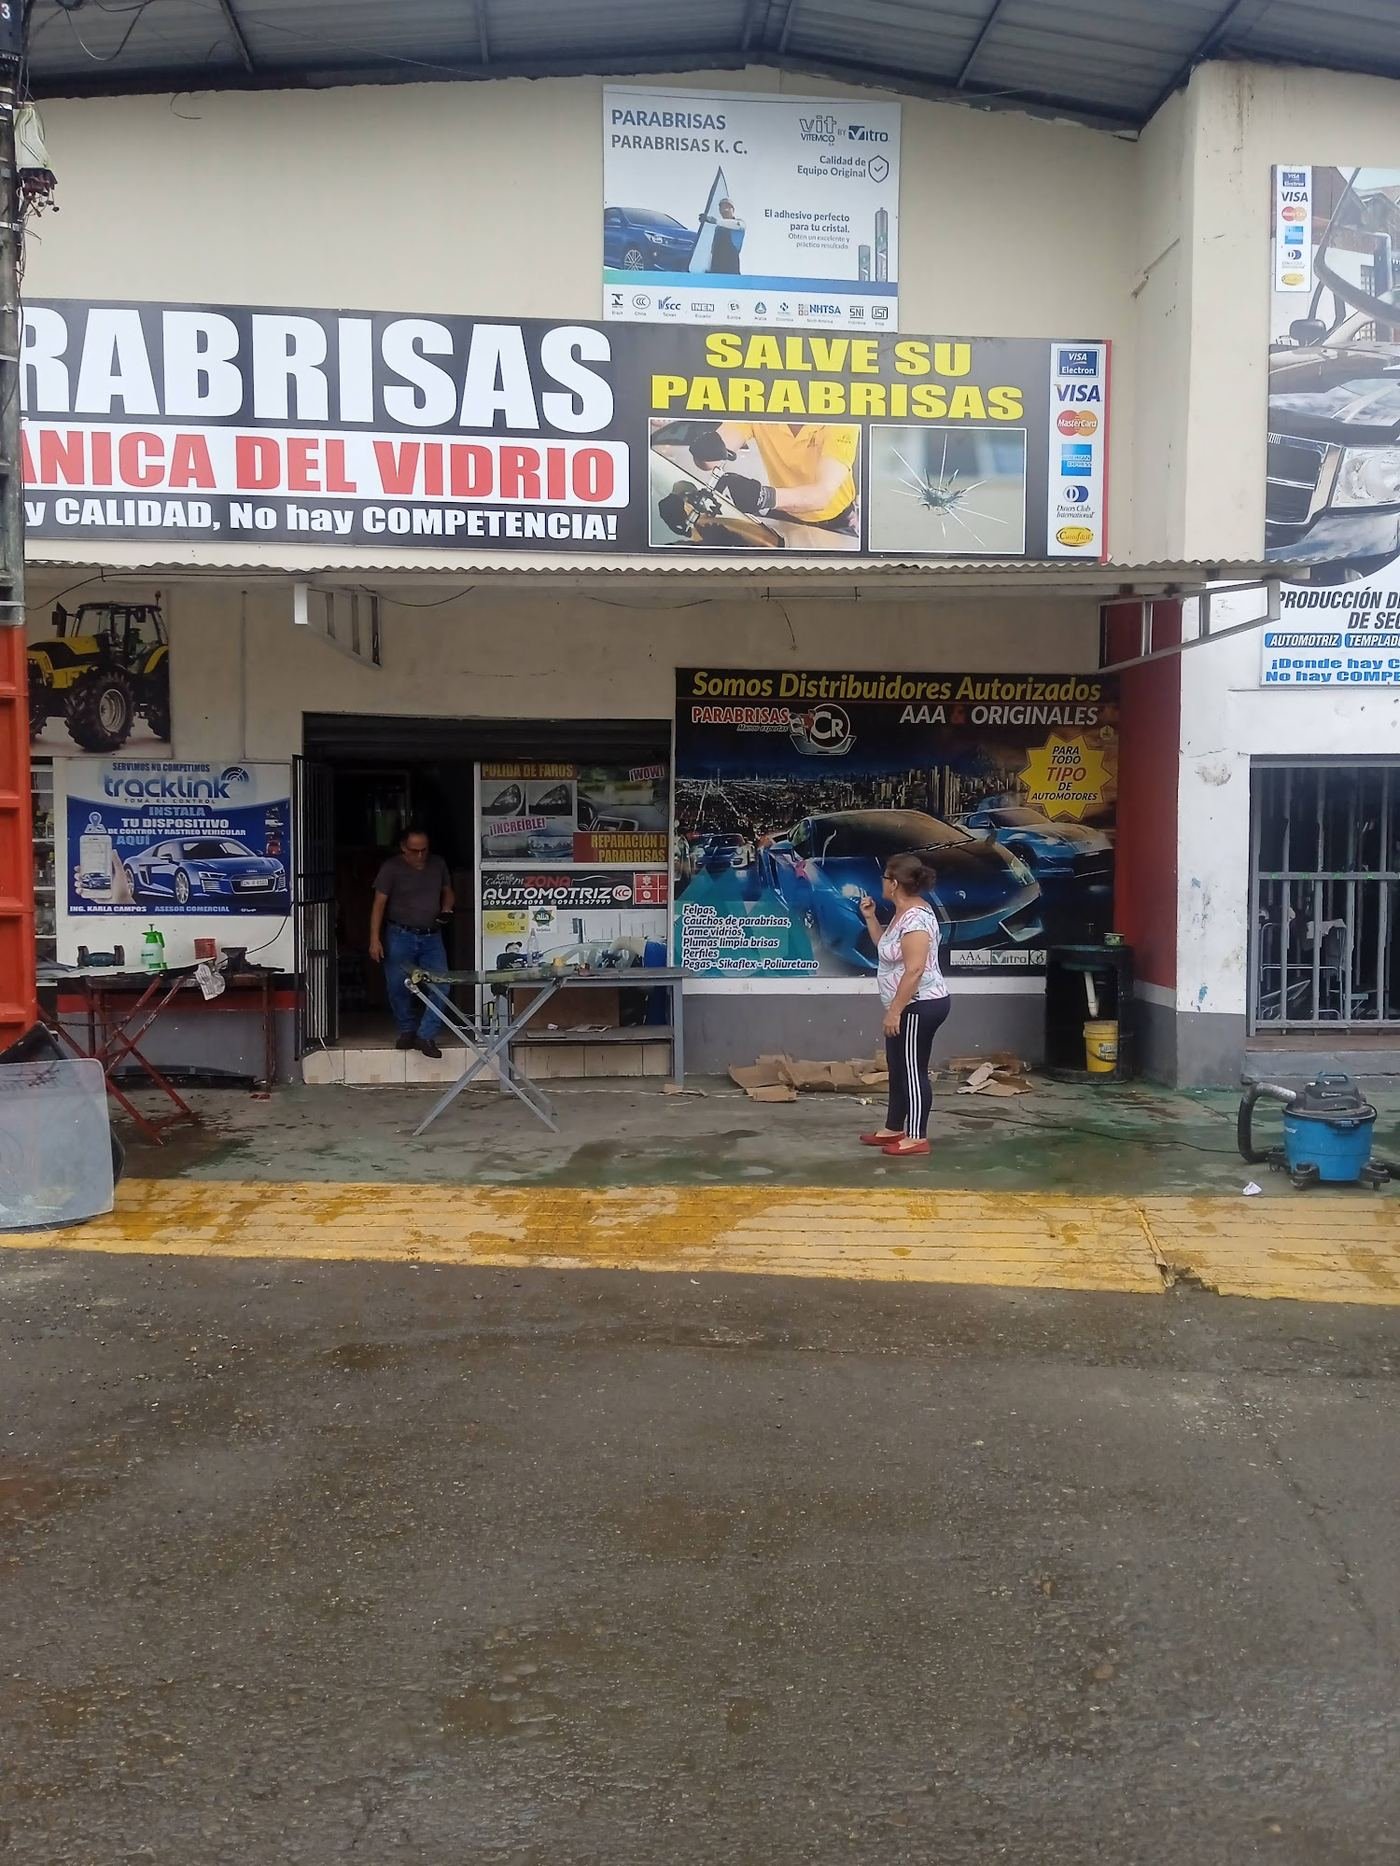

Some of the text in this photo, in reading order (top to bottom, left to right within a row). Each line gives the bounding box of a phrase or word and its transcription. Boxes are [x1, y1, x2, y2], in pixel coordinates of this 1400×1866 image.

[611, 109, 726, 130] PARABRISAS
[801, 133, 836, 143] VITEMCO
[849, 126, 889, 142] Vitro
[611, 134, 748, 154] PARABRISAS K. C.
[820, 155, 867, 166] Calidad de
[797, 165, 866, 178] Equipo Original
[1281, 192, 1308, 202] VISA
[764, 209, 850, 222] El adhesivo perfecto
[790, 223, 850, 233] para tu cristal.
[809, 304, 841, 314] NHTSA
[705, 333, 972, 377] SALVE SU
[1068, 353, 1087, 361] VISA
[1061, 366, 1095, 374] Electron
[651, 374, 1024, 420] PARABRISAS
[1054, 383, 1101, 402] VISA
[1057, 419, 1097, 428] MasterCard
[235, 436, 357, 493] DEL
[373, 440, 615, 502] VIDRIO
[25, 498, 618, 541] y CALIDAD, No hay COMPETENCIA!
[1386, 592, 1400, 608] D
[1348, 612, 1371, 629] DE
[1270, 635, 1340, 646] AUTOMOTRIZ
[1272, 658, 1342, 669] ¡Donde
[1347, 658, 1383, 669] hay
[1266, 672, 1291, 681] No
[1296, 671, 1332, 682] hay
[692, 671, 1101, 701] Somos Distribuidores Autorizados
[692, 706, 789, 724] PARABRISAS
[900, 705, 946, 724] AAA
[971, 705, 1098, 725] ORIGINALES
[1052, 746, 1079, 755] PARA
[1051, 755, 1081, 765] TODO
[113, 762, 210, 772] SERVIMOS NO COMPETIMOS
[523, 764, 537, 777] DE
[539, 764, 573, 777] FAROS
[1047, 767, 1086, 782] TIPO
[104, 774, 230, 799] tracklink
[1058, 782, 1073, 791] DE
[1031, 792, 1098, 801] AUTOMOTORES
[149, 806, 206, 817] INSTALA
[121, 818, 229, 829] TU DISPOSITIVO
[489, 817, 545, 835] ¡INCREÍBLE!
[116, 835, 150, 846] AQUÍ
[591, 832, 653, 847] REPARACIÓN
[598, 849, 666, 862] PARABRISAS
[524, 876, 571, 887] ZONA
[482, 887, 630, 900] AUTOMOTRIZ KC
[683, 905, 716, 916] Felpas,
[683, 915, 791, 927] Cauchos de parabrisas,
[683, 926, 745, 937] Lame vidrios,
[683, 937, 778, 949] Plumas limpia brisas
[683, 949, 718, 959] Perfiles
[683, 960, 711, 970] Pegas
[719, 959, 757, 970] Sikaflex
[763, 959, 819, 969] Poliuretano
